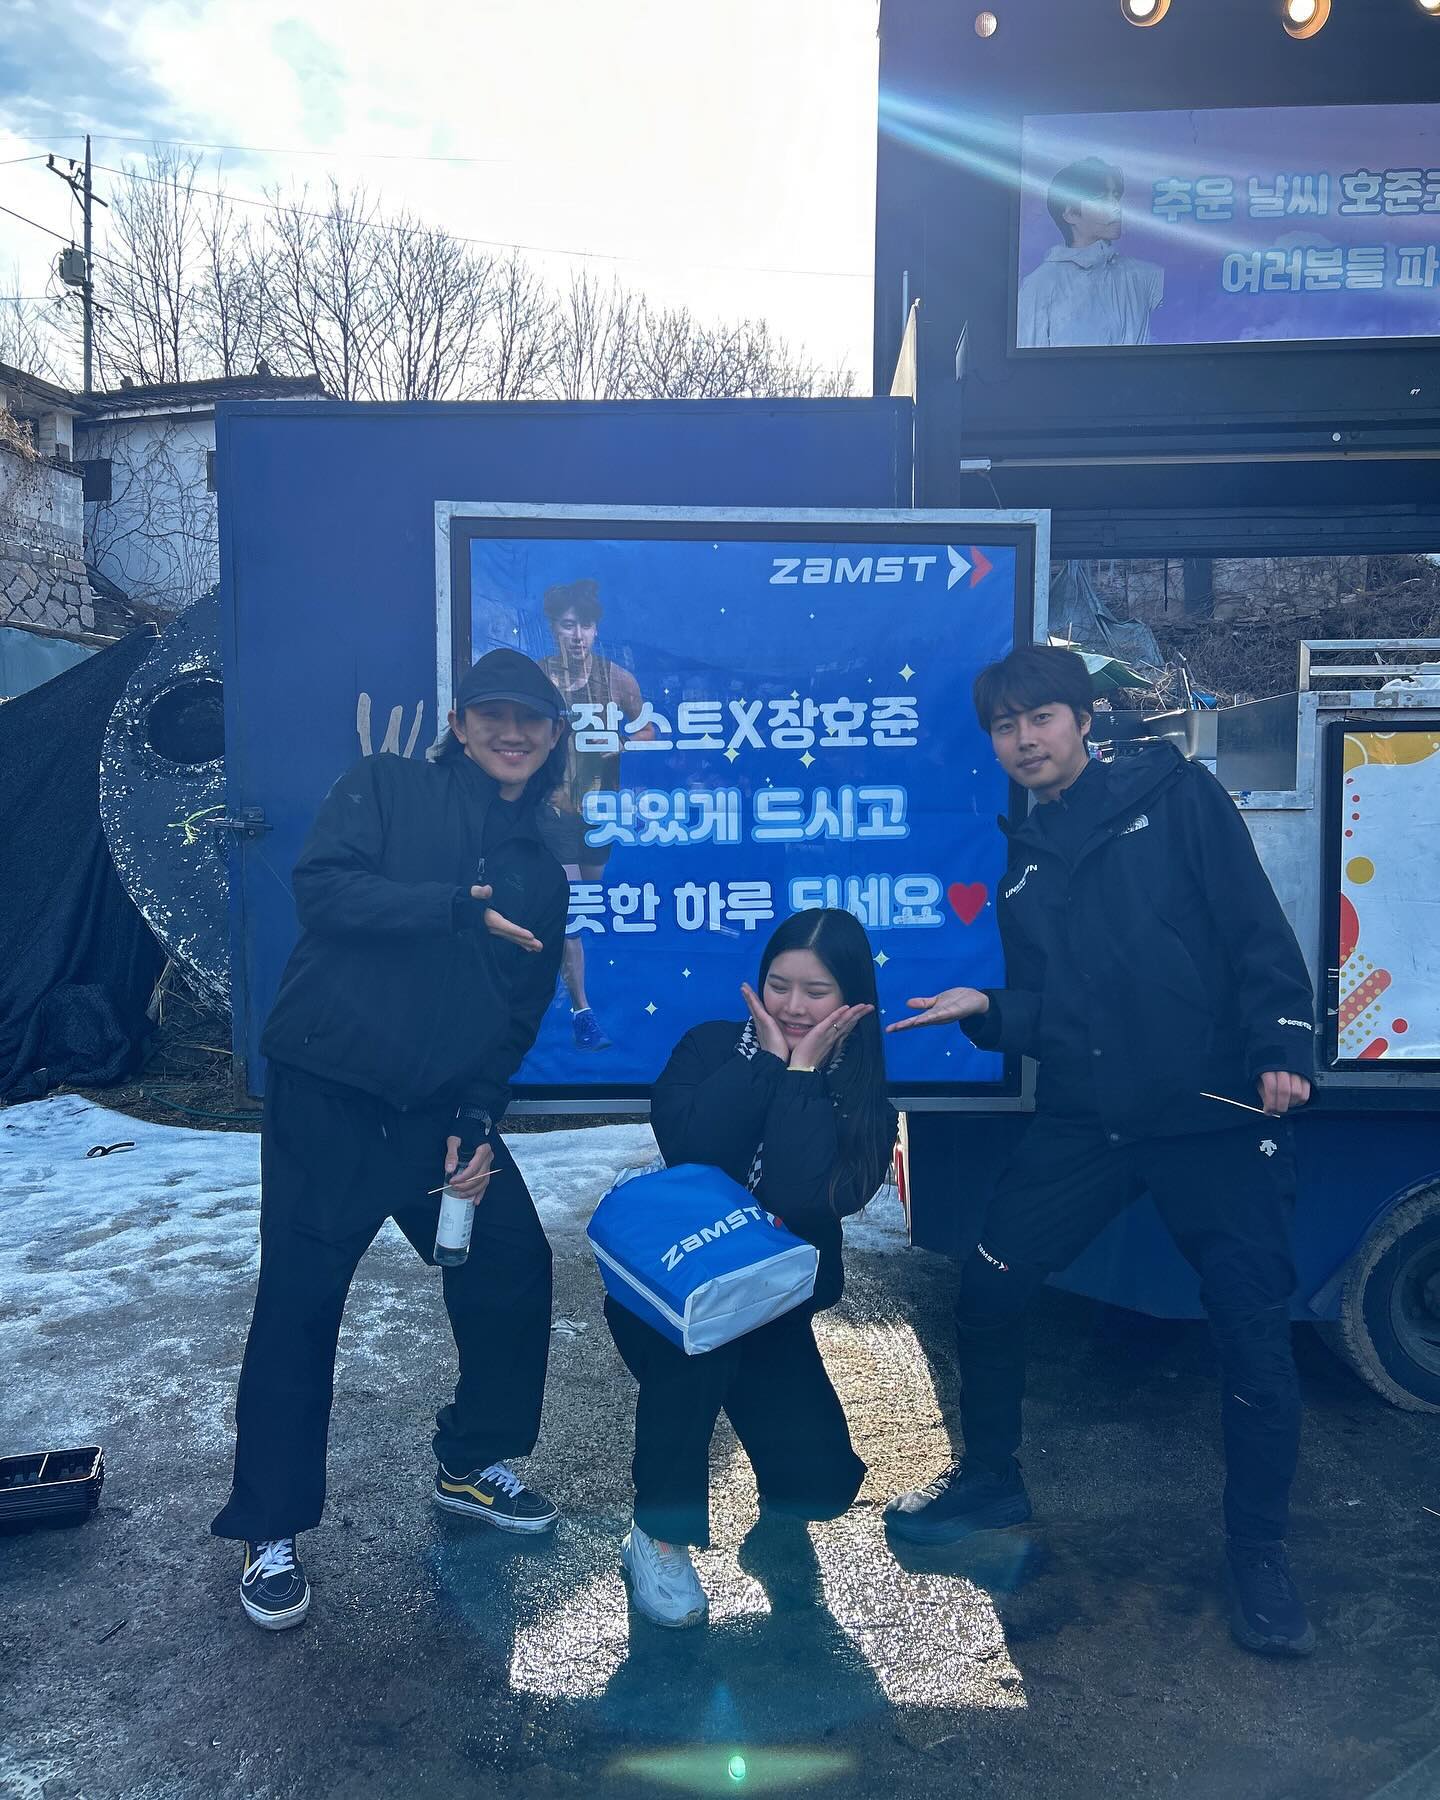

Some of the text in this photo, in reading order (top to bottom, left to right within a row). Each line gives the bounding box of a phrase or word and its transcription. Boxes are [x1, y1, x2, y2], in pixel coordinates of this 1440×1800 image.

[1153, 177, 1233, 223] 추운
[1249, 173, 1329, 218] 날씨
[1222, 247, 1385, 293] 여러분들
[584, 786, 908, 845] 맛있게 드시고
[565, 882, 660, 933] 뜻한
[673, 881, 775, 931] 하루
